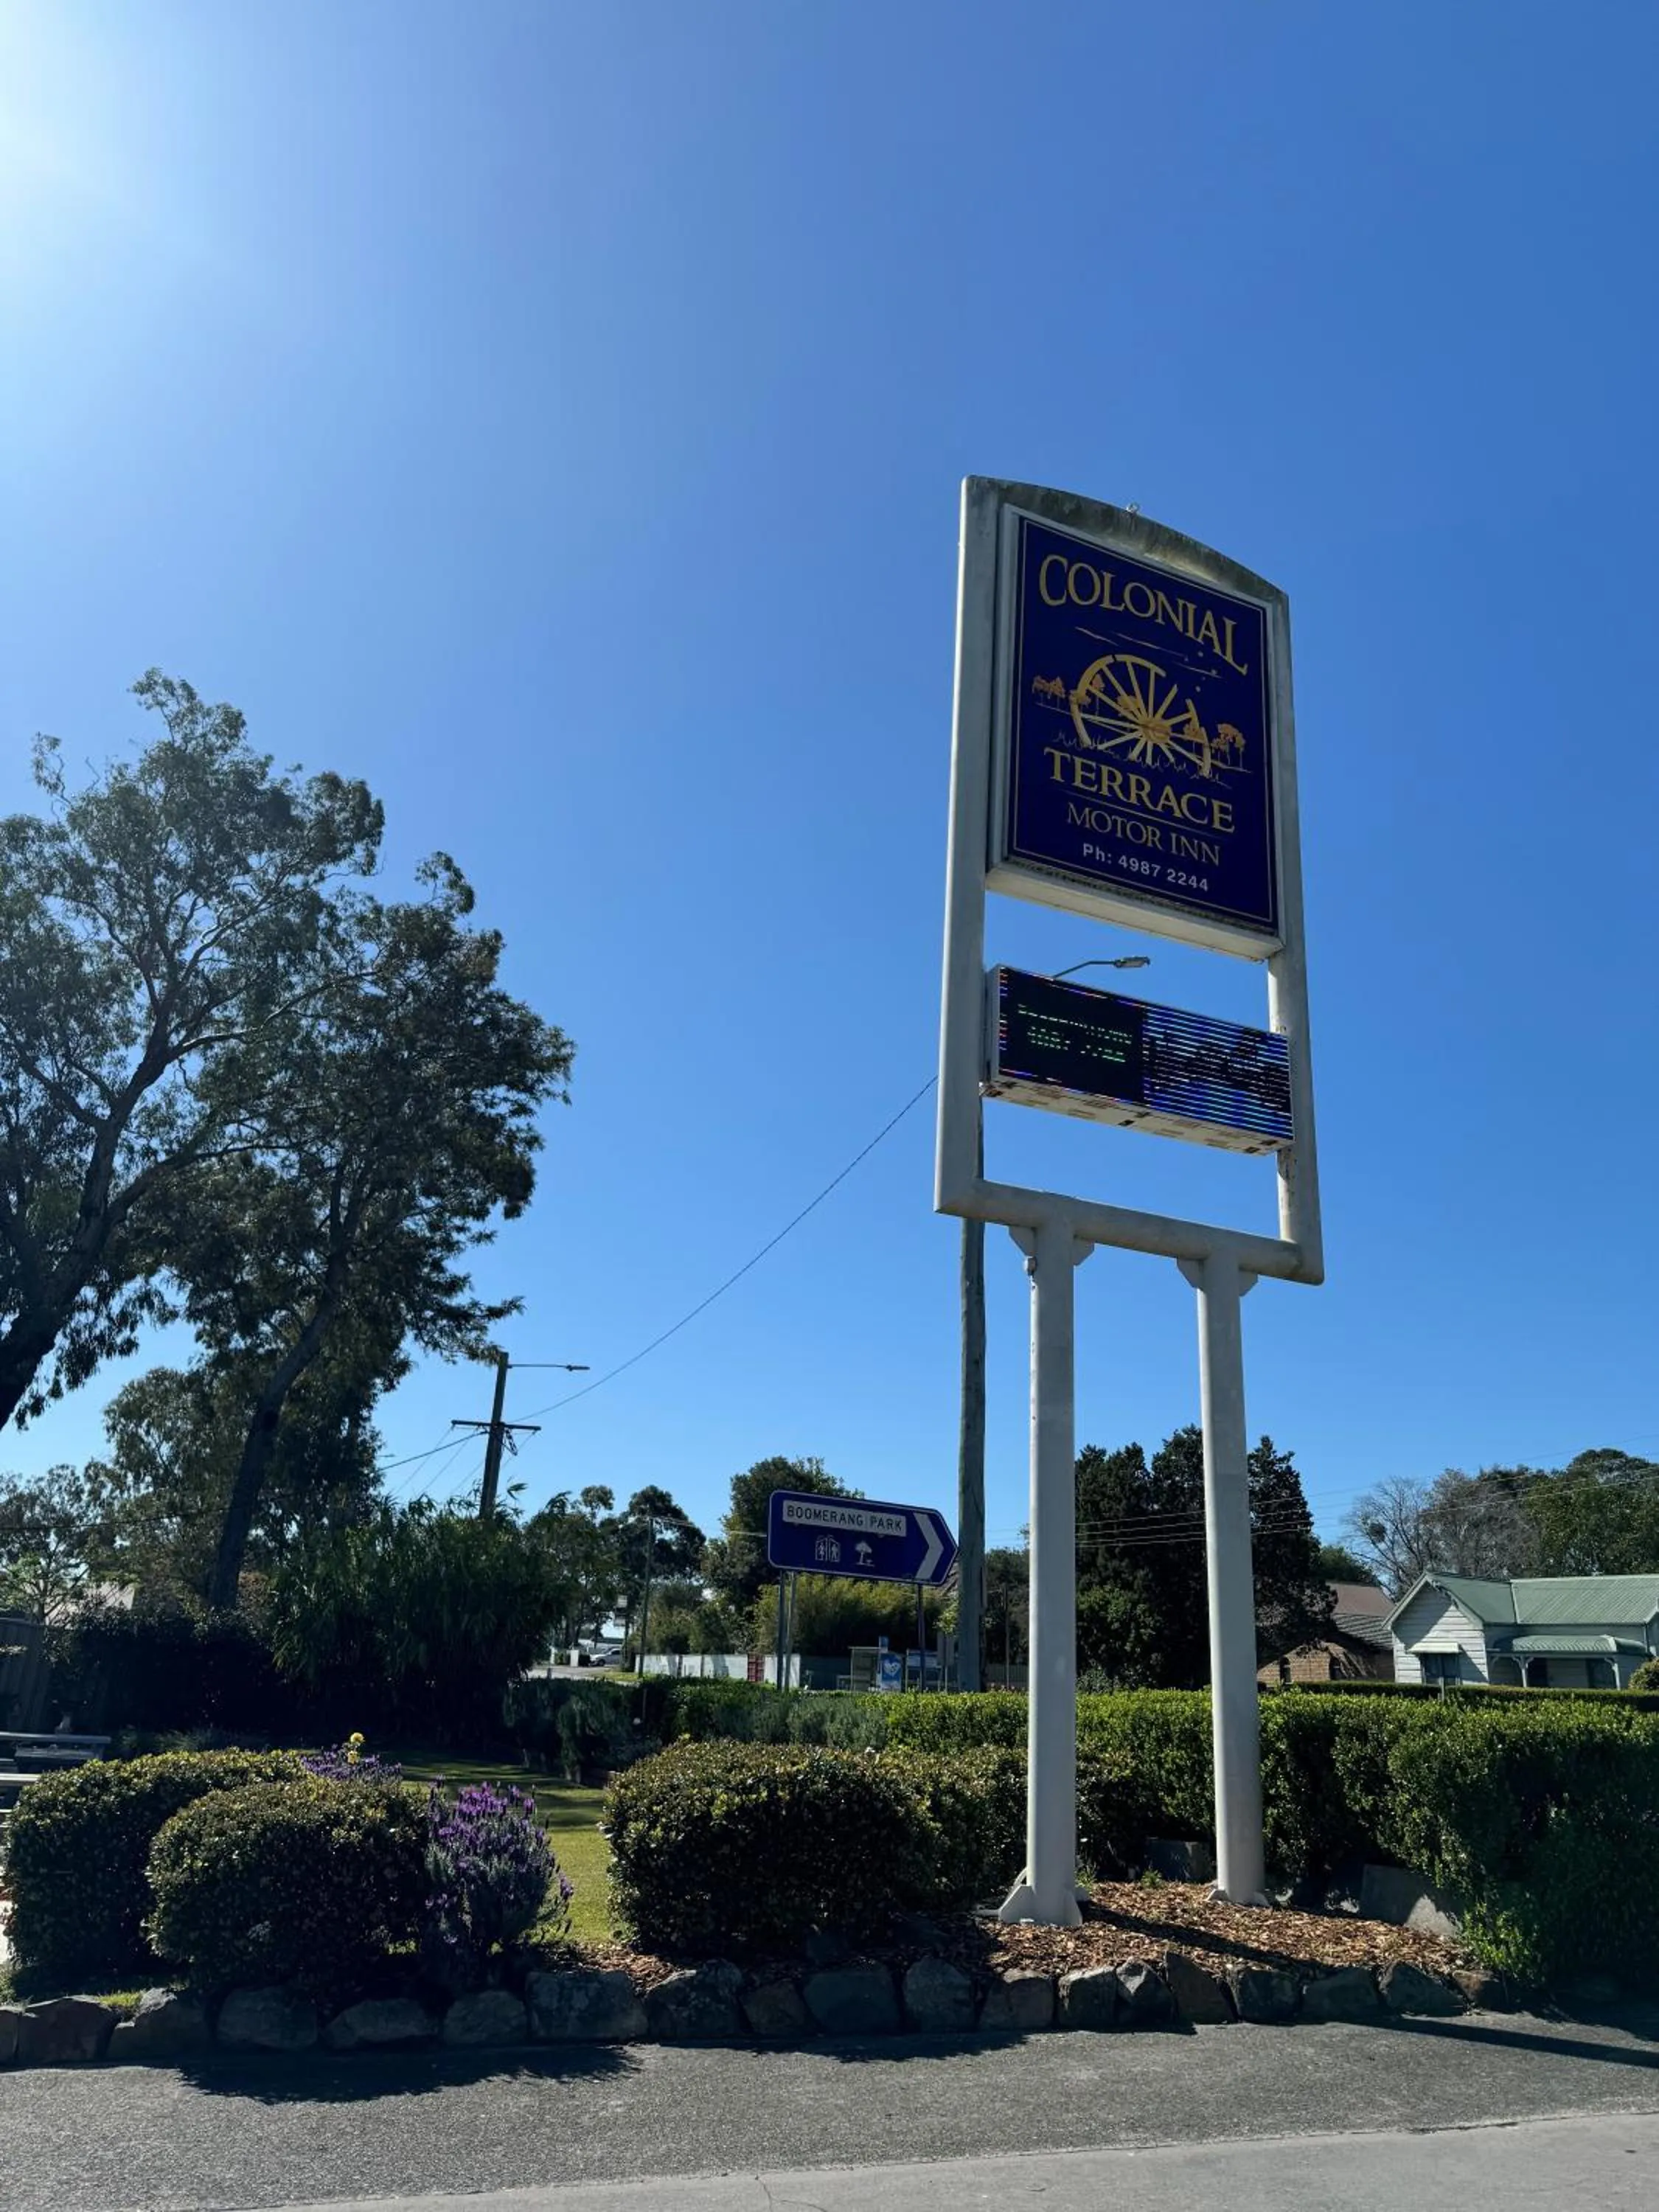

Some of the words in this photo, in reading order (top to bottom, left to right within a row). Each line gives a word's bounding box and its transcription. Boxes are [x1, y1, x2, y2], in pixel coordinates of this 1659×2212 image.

[1039, 554, 1248, 675] COLONIAL
[1043, 746, 1236, 833] TERRACE
[1067, 801, 1163, 851] MOTOR
[1169, 832, 1220, 866] INN
[1082, 843, 1113, 864] Ph:
[1118, 855, 1161, 877] 4987
[1166, 868, 1209, 892] 2244
[786, 1504, 864, 1526] BOOMERANG
[870, 1516, 902, 1532] PARK
